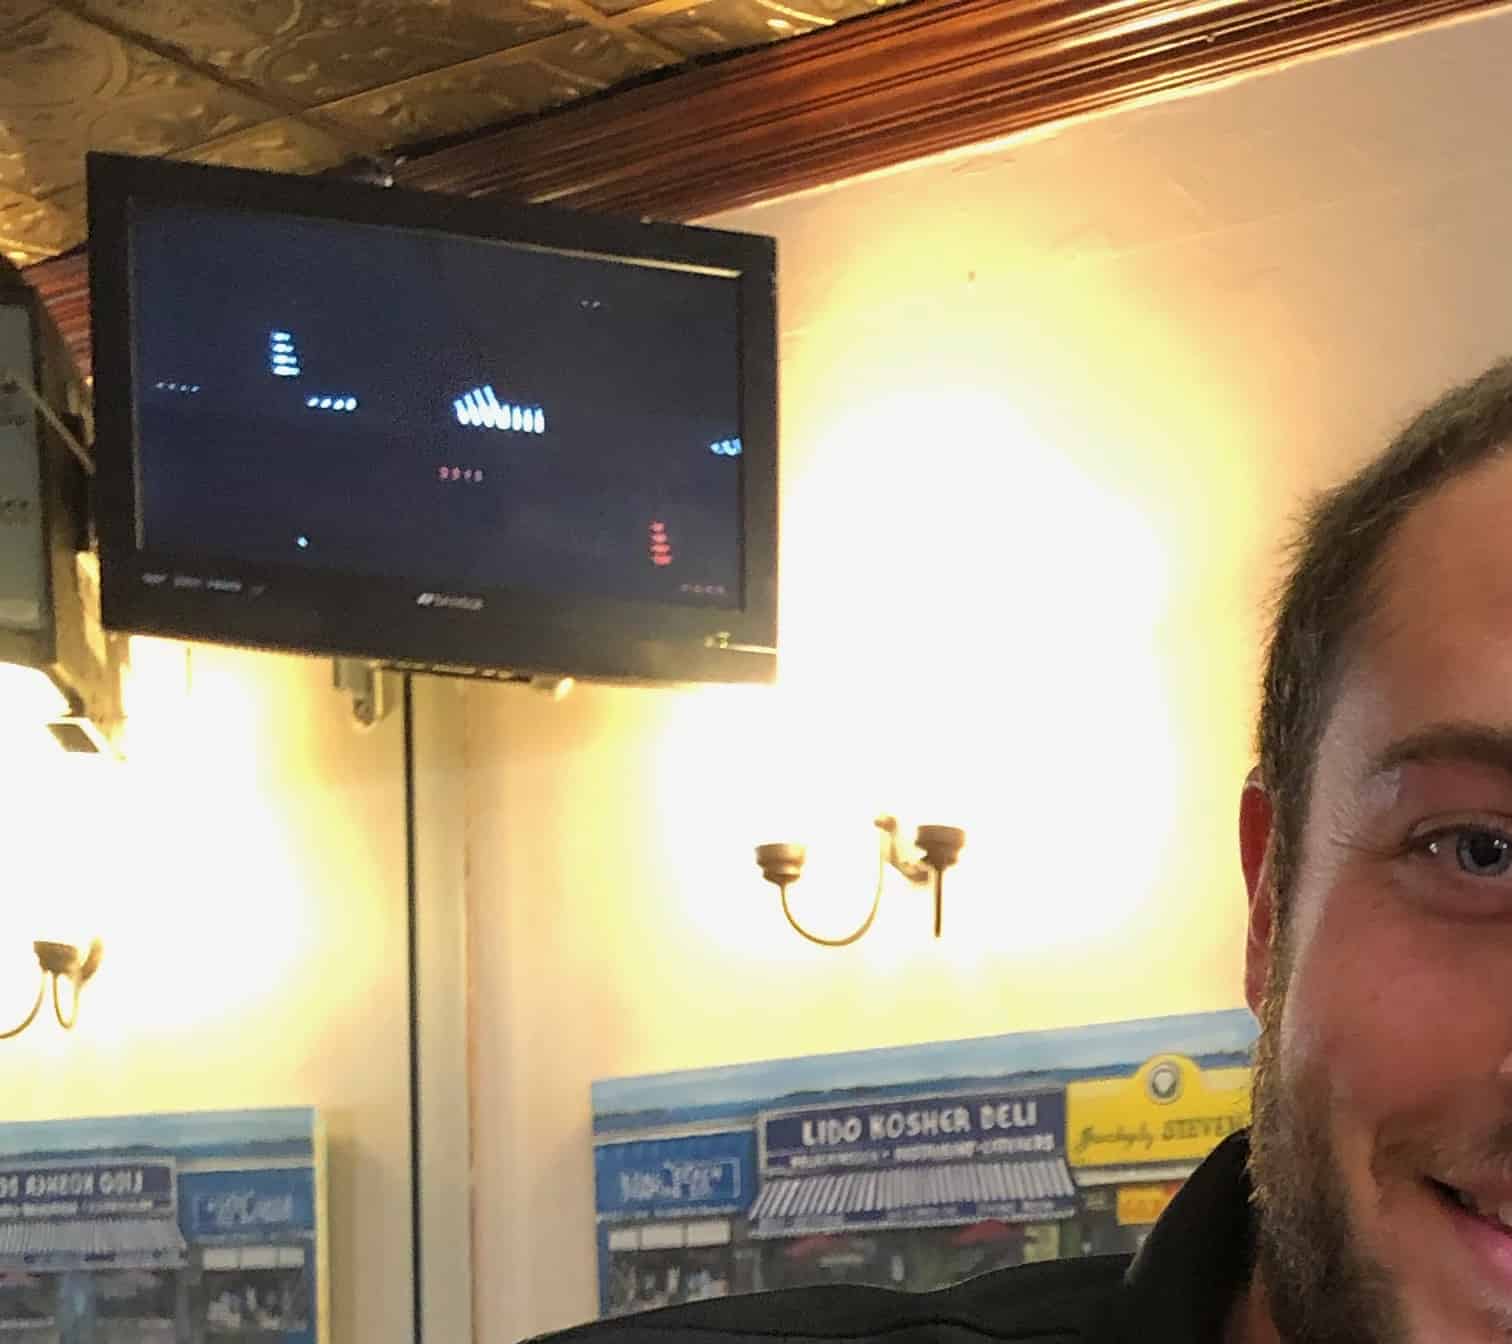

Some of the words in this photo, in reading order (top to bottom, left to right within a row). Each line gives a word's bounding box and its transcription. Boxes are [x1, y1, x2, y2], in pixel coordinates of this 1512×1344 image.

[802, 1117, 863, 1147] LIDO
[869, 1107, 971, 1141] KOSHER
[979, 1101, 1037, 1130] DELI
